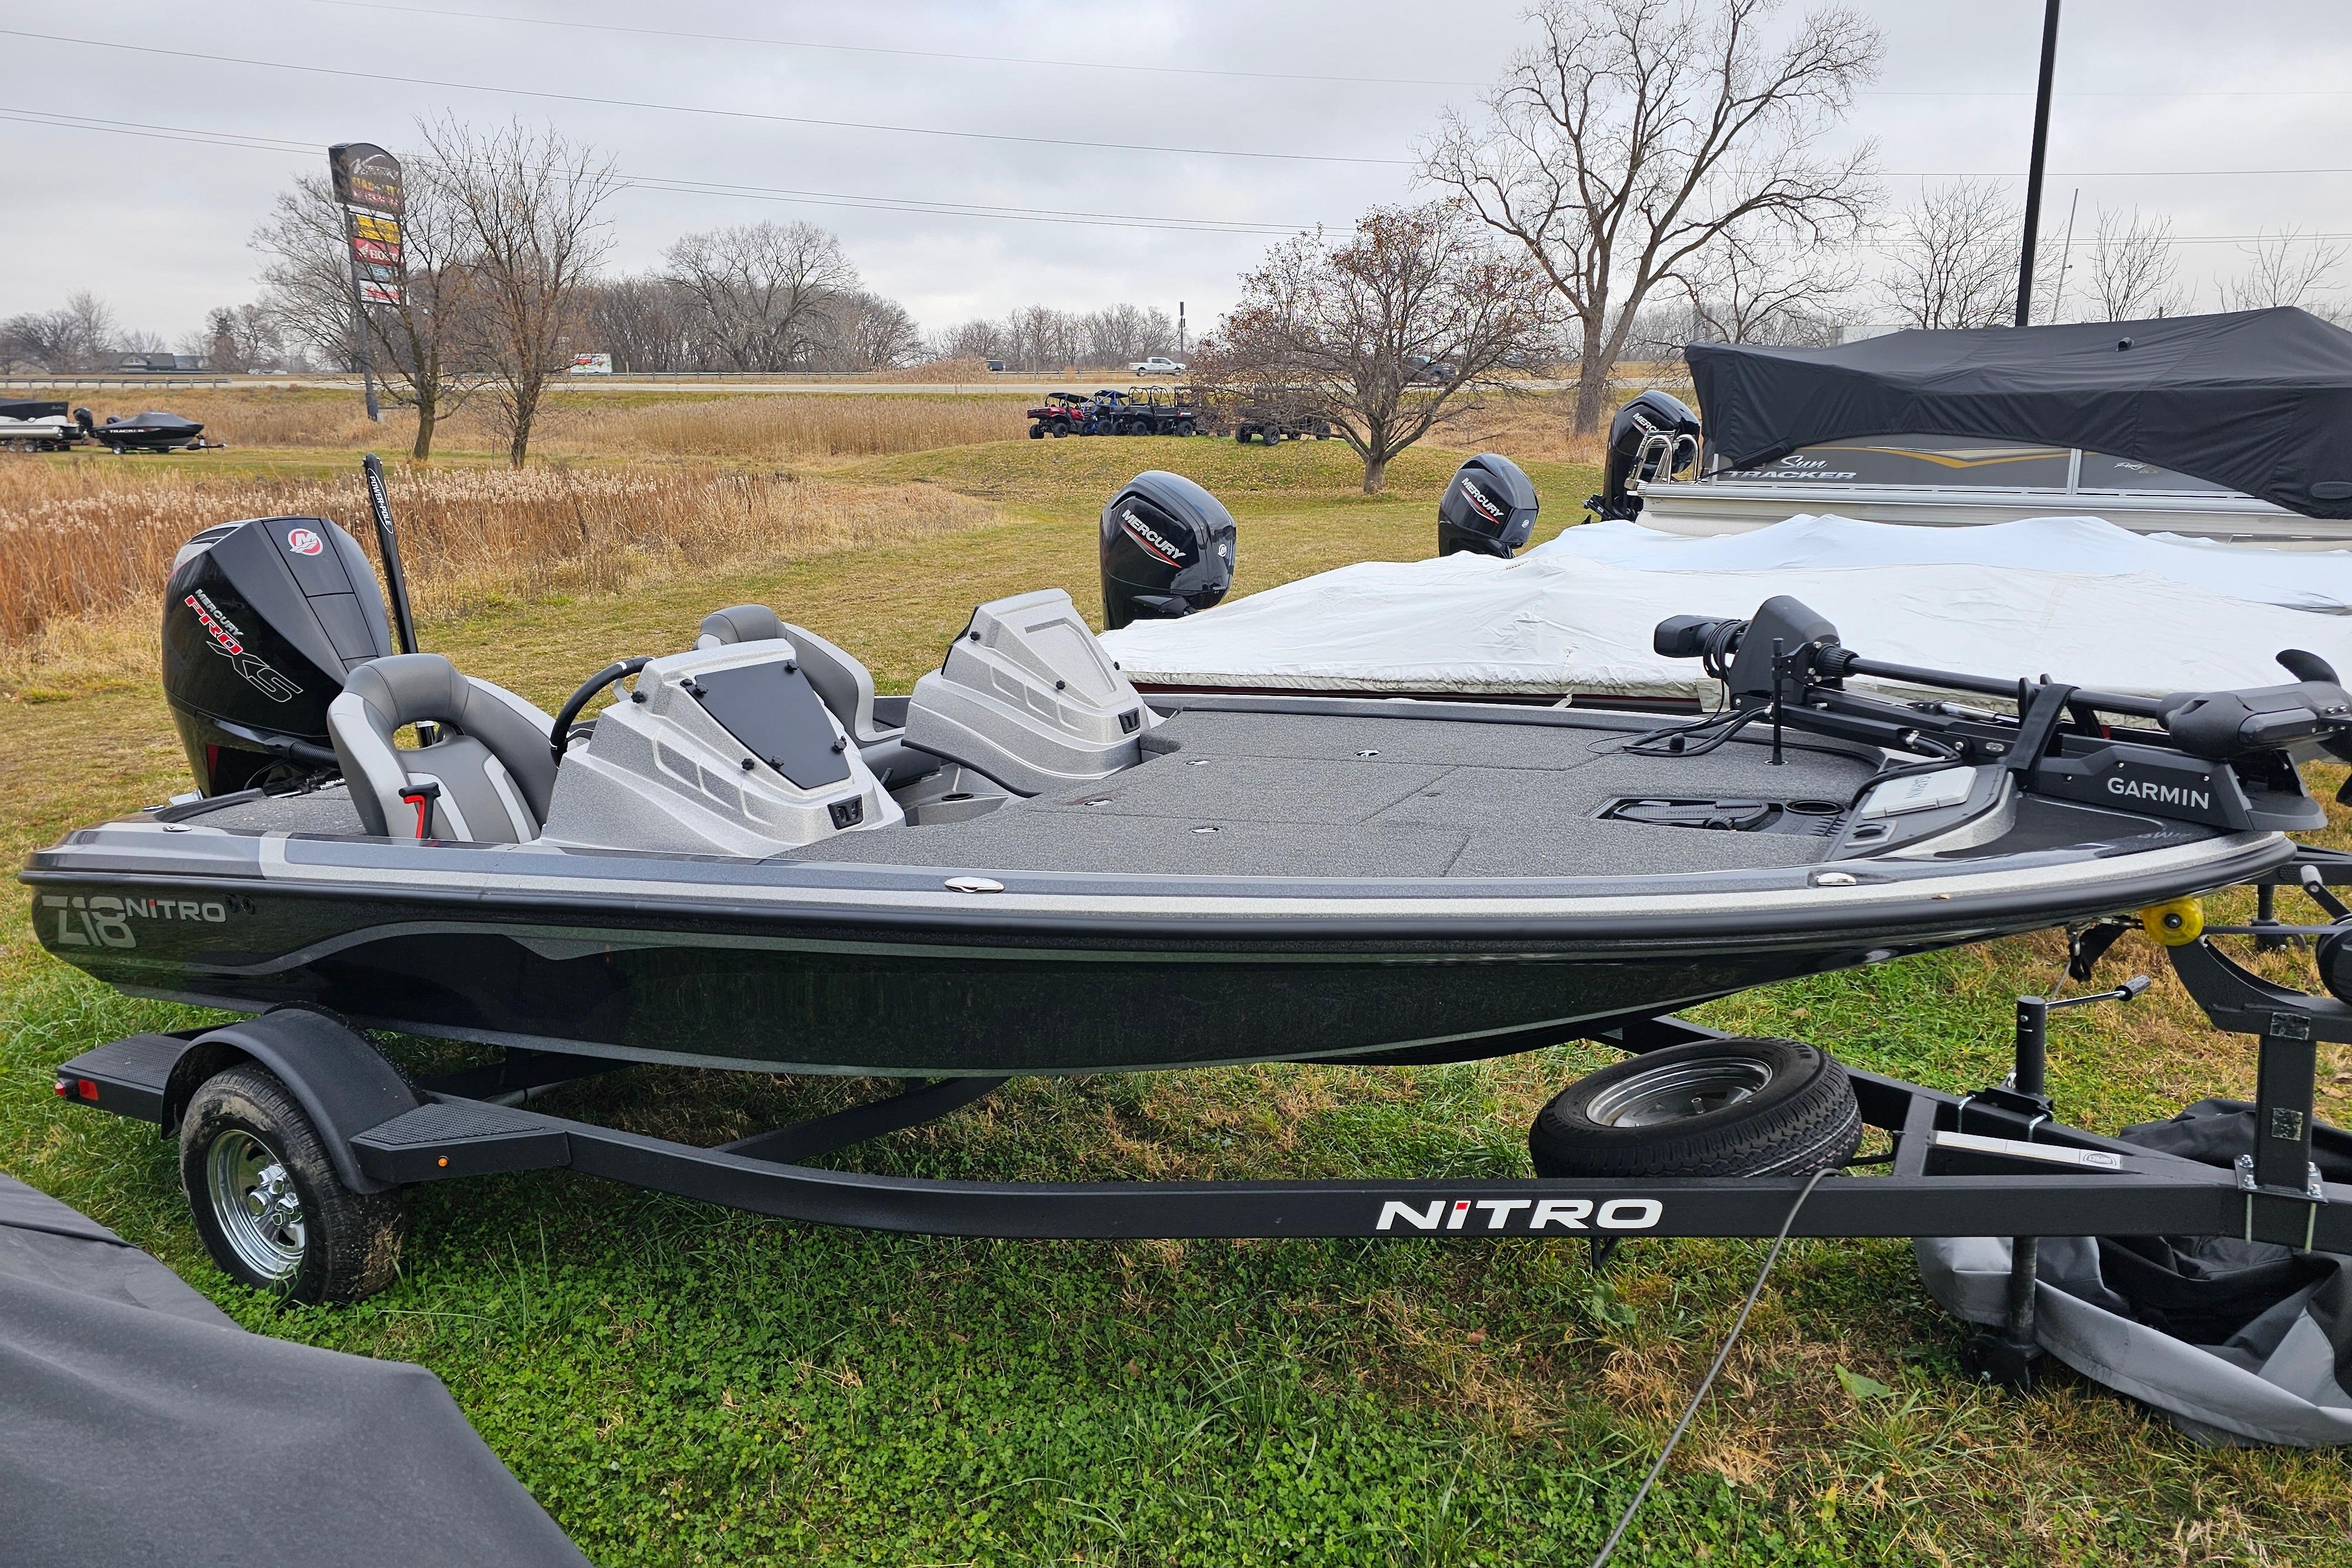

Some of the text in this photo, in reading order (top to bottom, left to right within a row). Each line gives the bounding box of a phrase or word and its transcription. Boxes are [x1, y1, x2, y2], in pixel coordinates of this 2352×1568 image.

[1724, 471, 1857, 479] TRACKER
[1773, 455, 1828, 469] Sun
[369, 476, 392, 526] POWER-POLE
[1461, 477, 1504, 516] MERCURY
[1121, 509, 1187, 559] MERCURY
[195, 589, 244, 635] MERCURY
[185, 595, 304, 702] PRO XS
[2107, 777, 2209, 810] GARMIN
[42, 895, 226, 948] Z18 NITRO
[1375, 1199, 1663, 1230] NITRO
